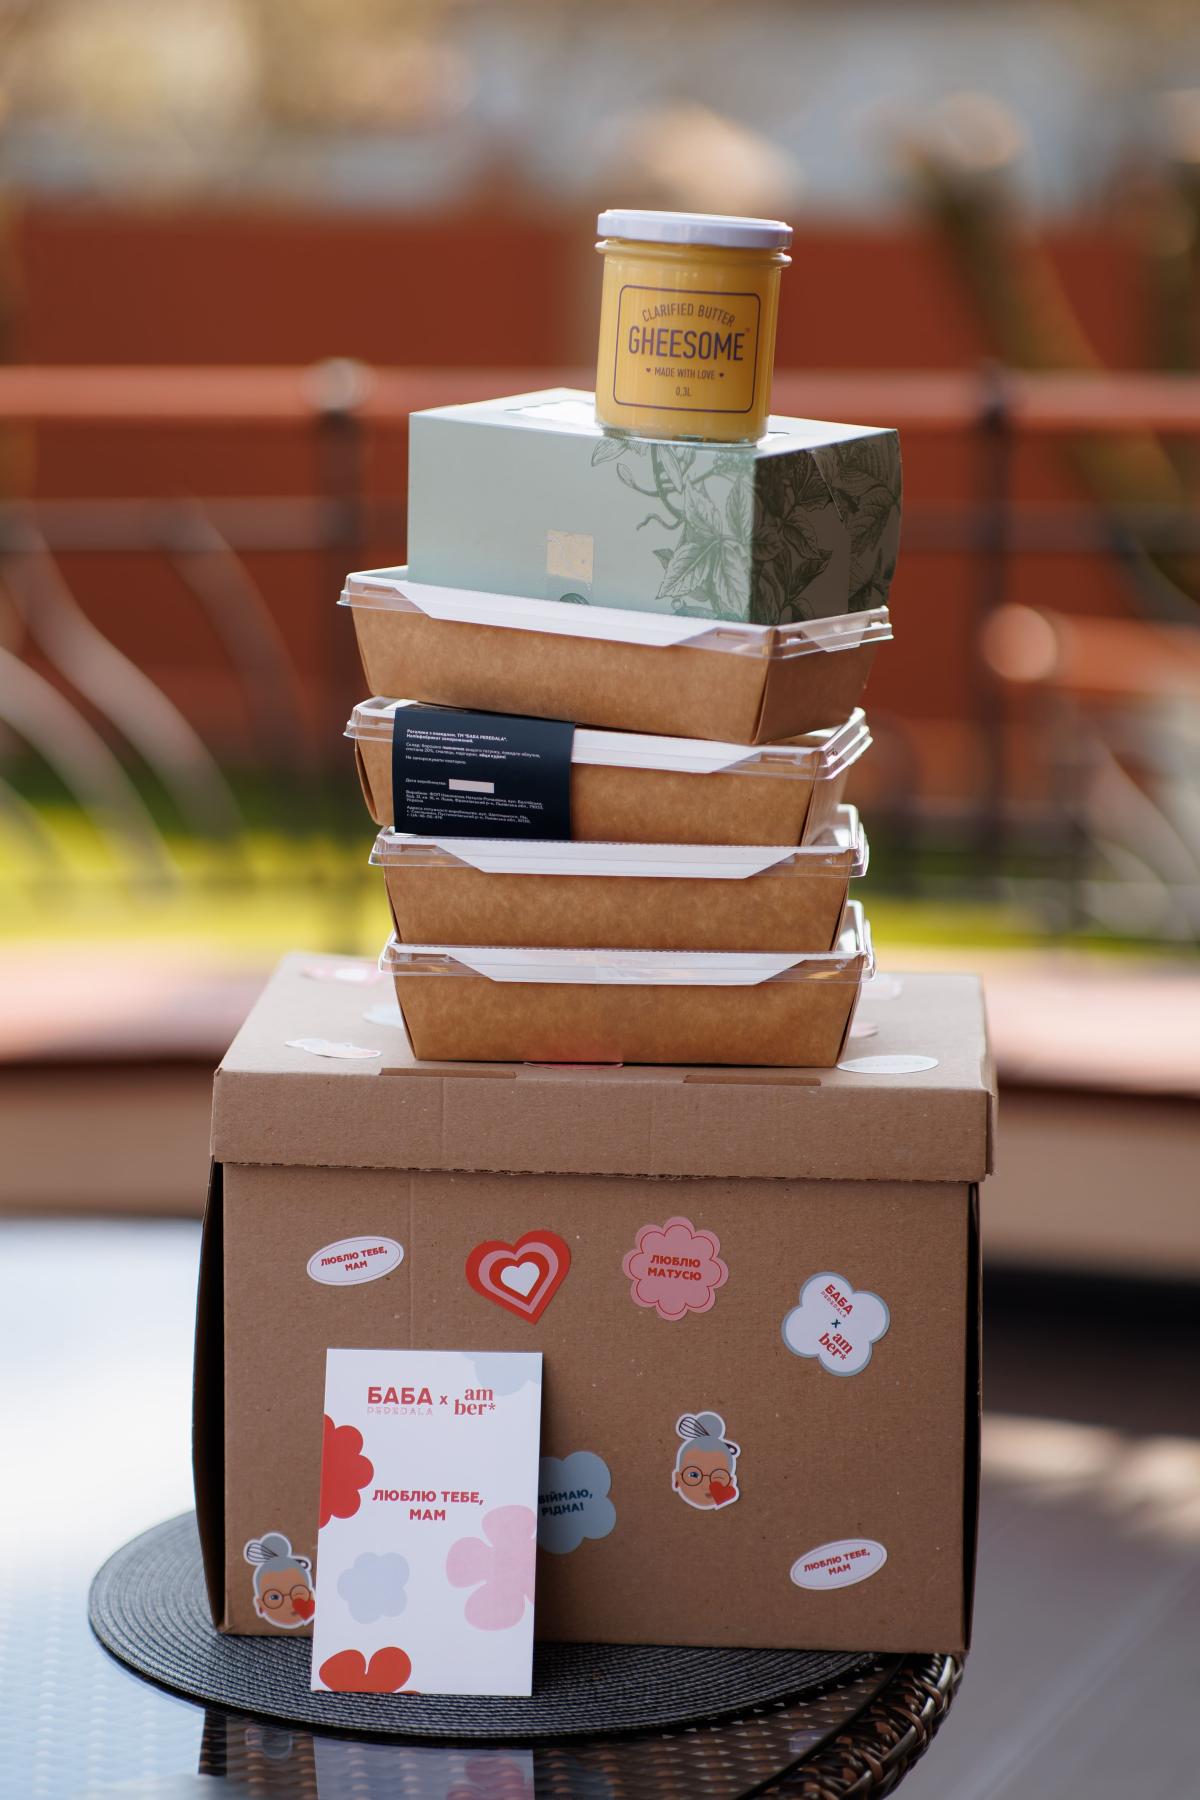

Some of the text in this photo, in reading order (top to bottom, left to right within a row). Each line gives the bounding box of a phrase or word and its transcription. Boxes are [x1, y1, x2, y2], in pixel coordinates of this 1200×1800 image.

[642, 303, 736, 328] CLARIFIED BUTTER
[628, 325, 745, 361] GHEESOME
[654, 367, 716, 380] MADE WITH LOVE
[321, 1246, 388, 1266] ЛЮБЛЮ ТЕБЕ,
[650, 1255, 701, 1268] ЛЮБЛЮ
[345, 1260, 368, 1271] МАМ
[647, 1267, 702, 1281] МАТУСЮ
[825, 1284, 853, 1315] БАБА
[832, 1333, 853, 1354] am
[367, 1386, 433, 1405] БАБА
[464, 1388, 494, 1401] am
[372, 1489, 484, 1506] ЛЮБЛЮ ТЕБЕ,
[538, 1489, 593, 1504] БІЙМАЮ,
[409, 1508, 446, 1521] МАМ
[803, 1556, 842, 1572] ЛЮБЛЮ
[828, 1564, 851, 1576] МАМ
